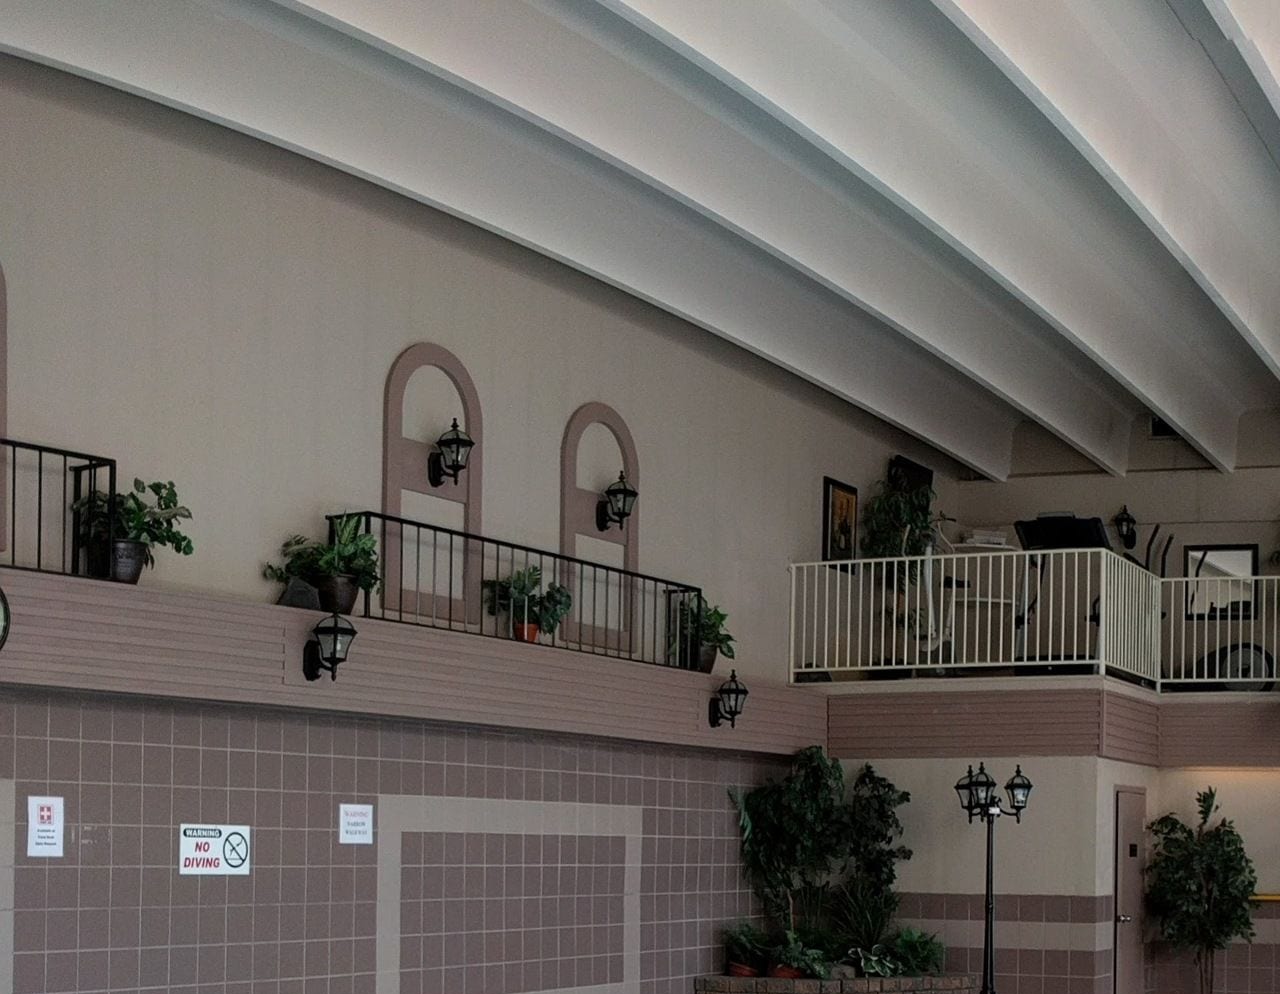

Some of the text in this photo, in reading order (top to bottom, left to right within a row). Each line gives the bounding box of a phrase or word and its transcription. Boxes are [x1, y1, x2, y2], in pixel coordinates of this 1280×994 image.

[185, 829, 220, 838] WARNING
[194, 841, 210, 853] NO
[183, 857, 220, 868] DIVING
